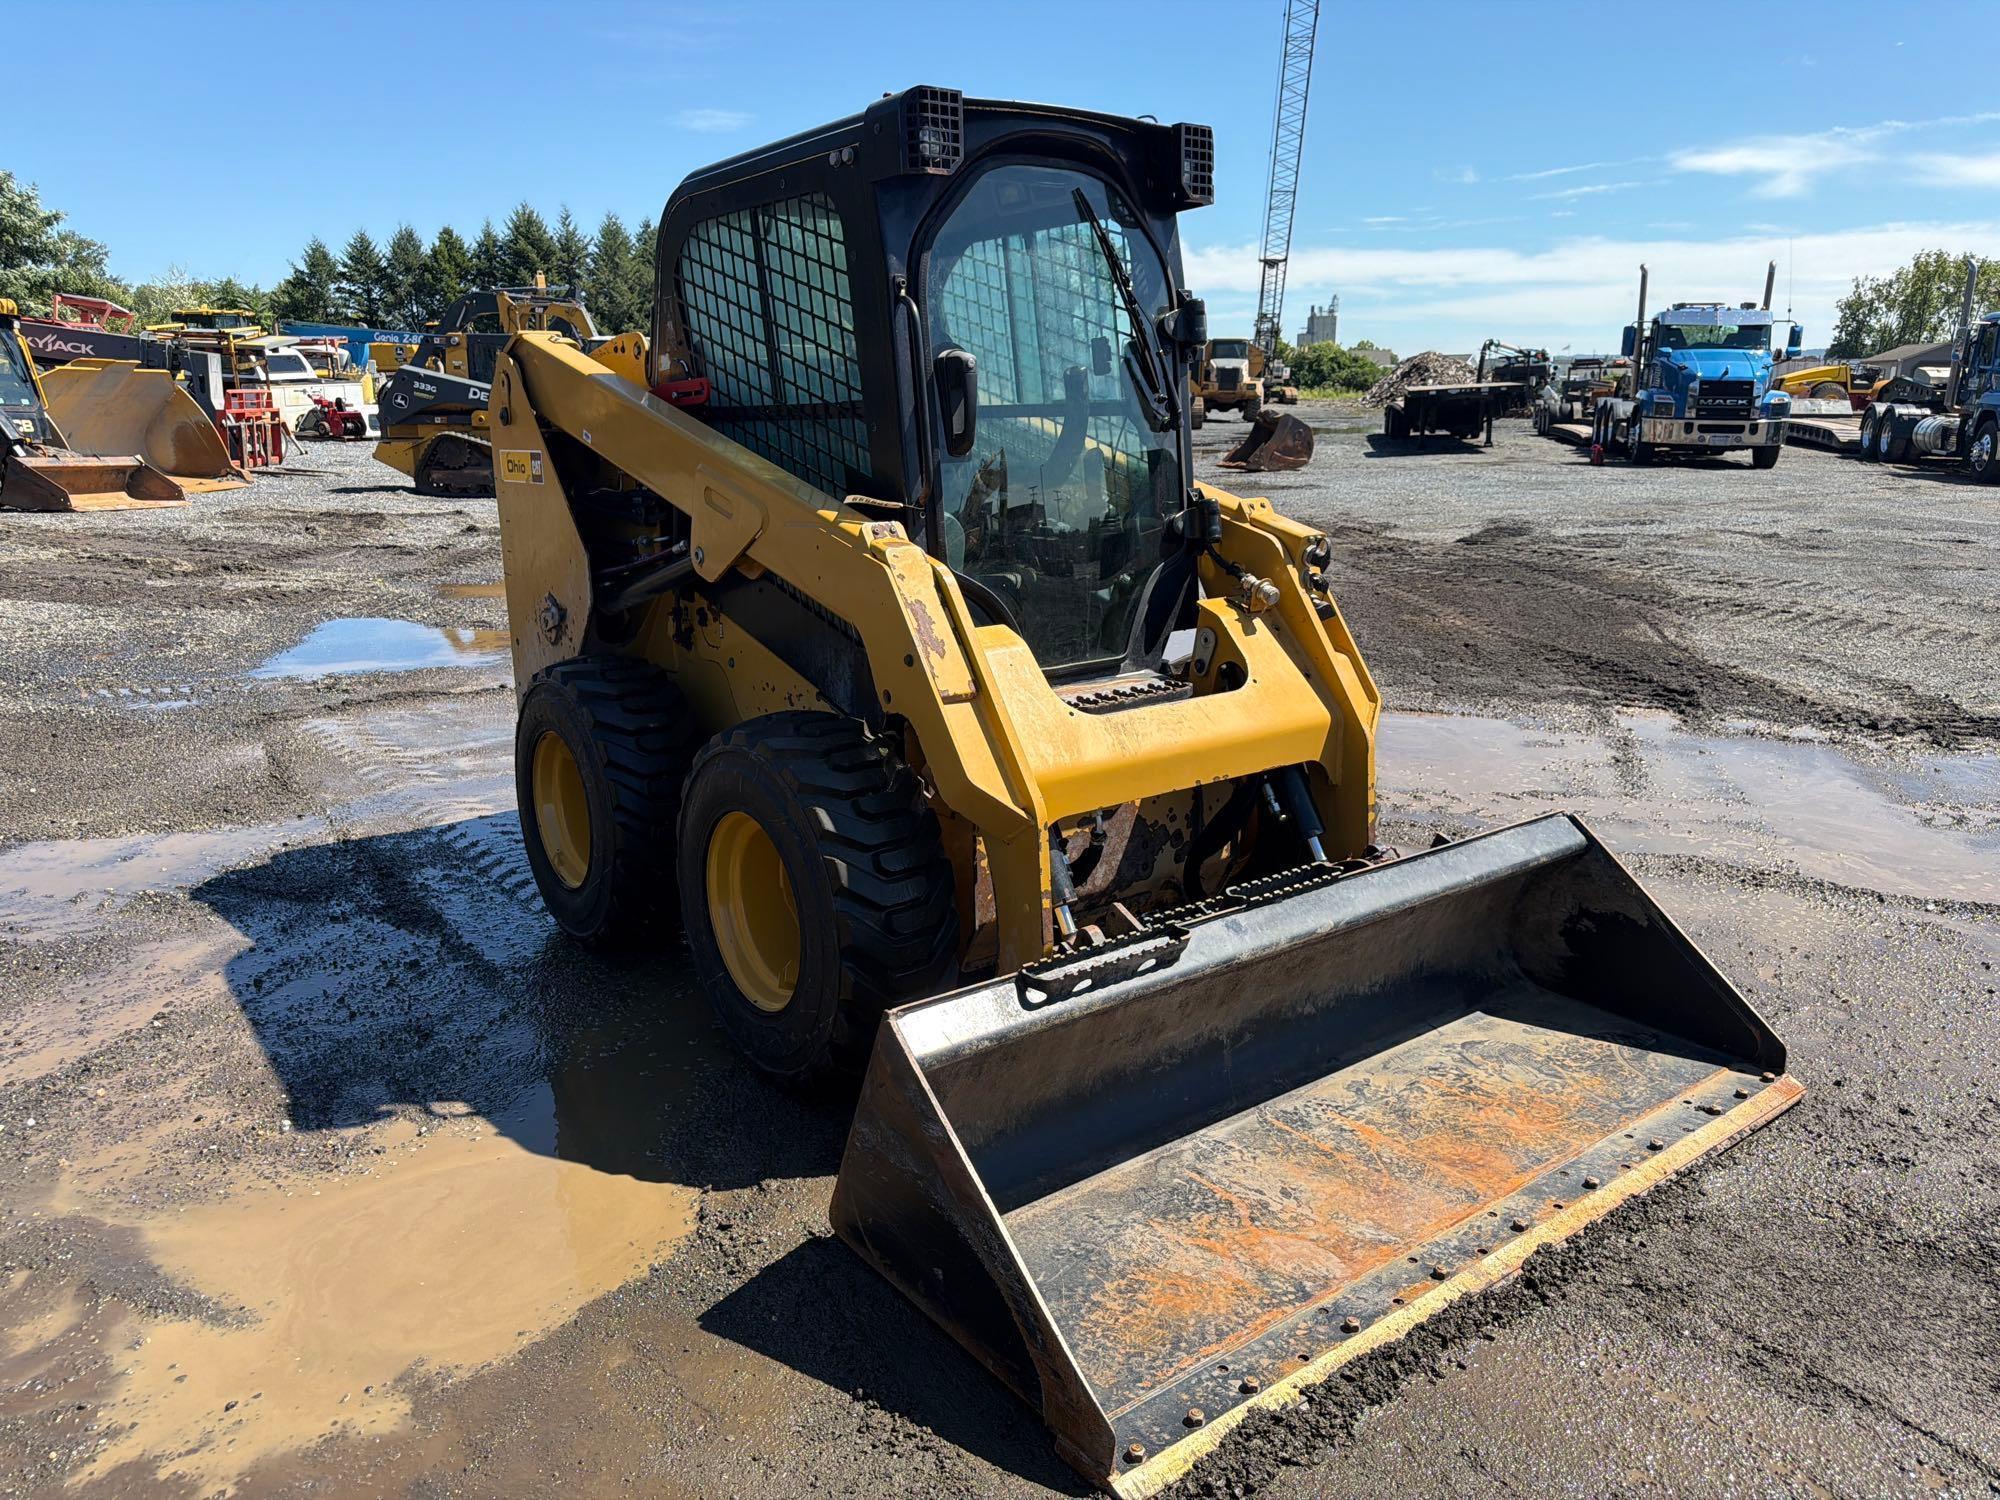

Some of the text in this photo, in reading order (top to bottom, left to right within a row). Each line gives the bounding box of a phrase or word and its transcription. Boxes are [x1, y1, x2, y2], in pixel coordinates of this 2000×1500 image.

[374, 332, 399, 343] Genie
[26, 333, 96, 356] KYJACK
[413, 381, 437, 393] 333G
[506, 459, 526, 474] Ohio
